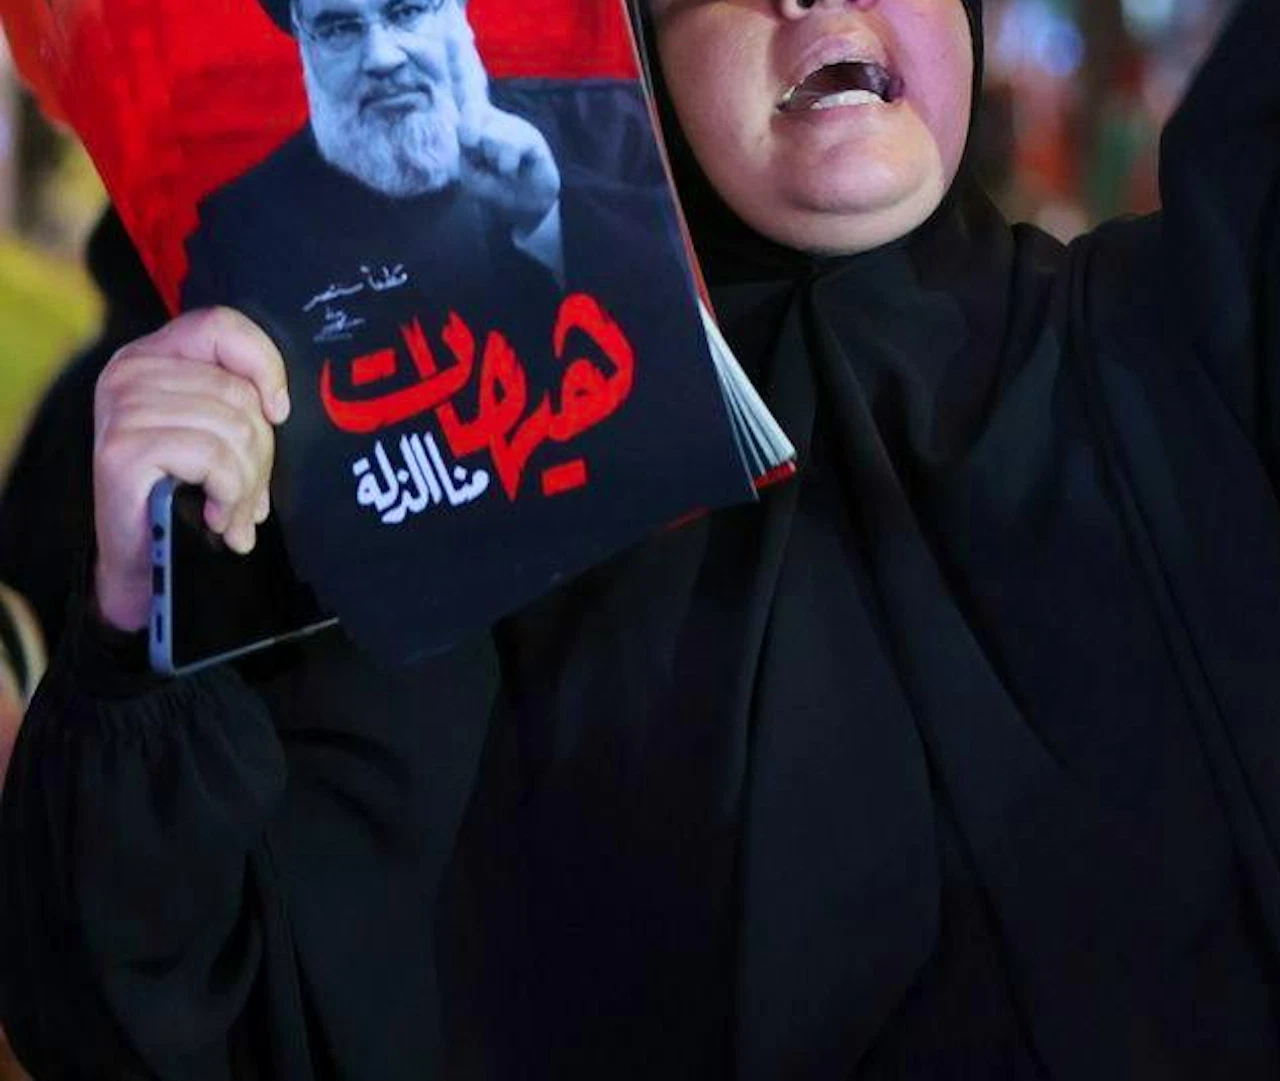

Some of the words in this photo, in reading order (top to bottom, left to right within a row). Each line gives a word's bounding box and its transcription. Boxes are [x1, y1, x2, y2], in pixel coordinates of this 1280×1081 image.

[320, 293, 636, 500] هيهات
[352, 433, 442, 524] الذلة
[424, 432, 489, 507] منا
